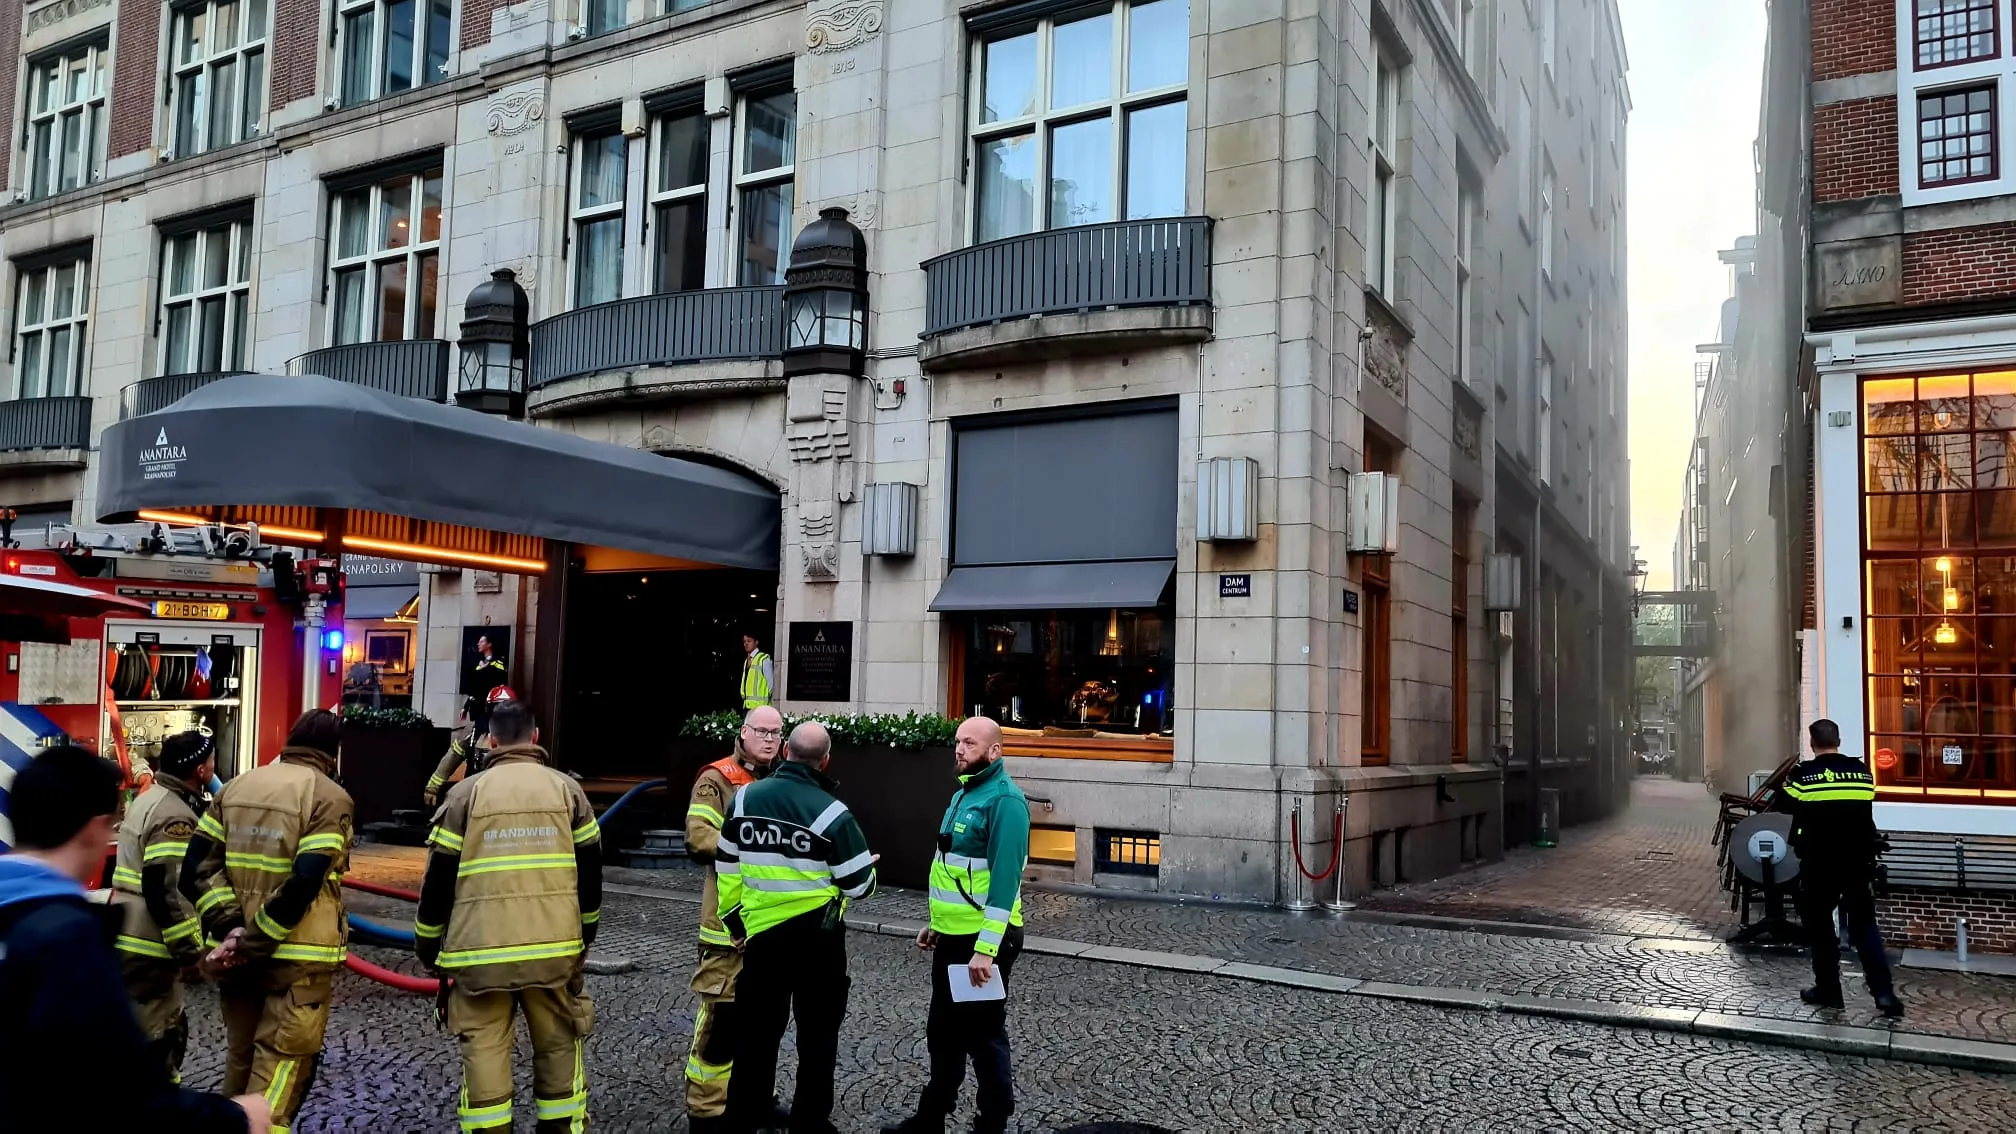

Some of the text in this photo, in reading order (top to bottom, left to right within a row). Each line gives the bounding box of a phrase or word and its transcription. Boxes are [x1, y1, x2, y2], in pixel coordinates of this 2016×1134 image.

[832, 58, 855, 75] 1913
[1832, 265, 1885, 287] ANNO
[139, 446, 187, 462] ANANTARA
[340, 562, 403, 575] ASNAPOLSKY
[1225, 578, 1244, 587] DAM
[794, 644, 846, 654] ANANTARA
[484, 826, 559, 841] BRANDWEER
[739, 821, 812, 853] OvD-G
